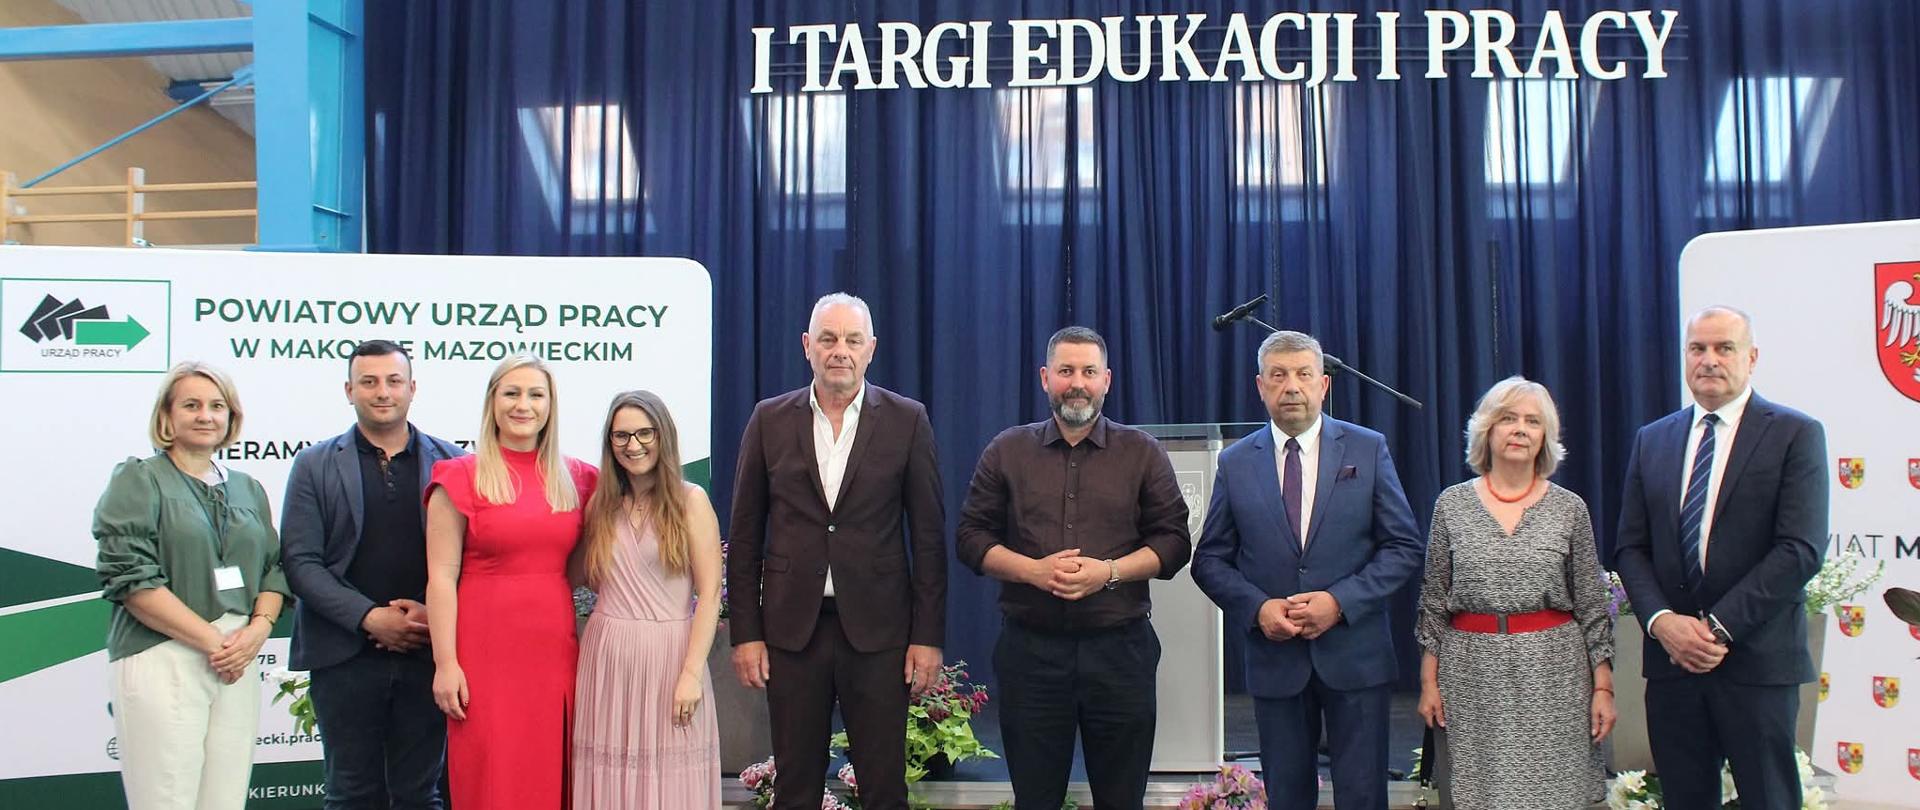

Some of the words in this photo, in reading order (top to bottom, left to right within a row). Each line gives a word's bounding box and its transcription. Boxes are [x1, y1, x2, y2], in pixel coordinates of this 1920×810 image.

[750, 27, 775, 93] I
[789, 21, 992, 91] TARGI
[1008, 12, 1357, 88] EDUKACJI
[1376, 12, 1400, 80] I
[1424, 10, 1678, 79] PRACY
[195, 299, 420, 326] POWIATOWY
[431, 303, 547, 333] URZĄD
[559, 305, 668, 328] PRACY
[41, 348, 79, 359] URZĄD
[83, 349, 121, 358] PRACY
[231, 338, 260, 358] W
[271, 339, 414, 360] MAKOE
[255, 732, 322, 746] ecki.prac
[248, 783, 326, 800] KIERUNK
